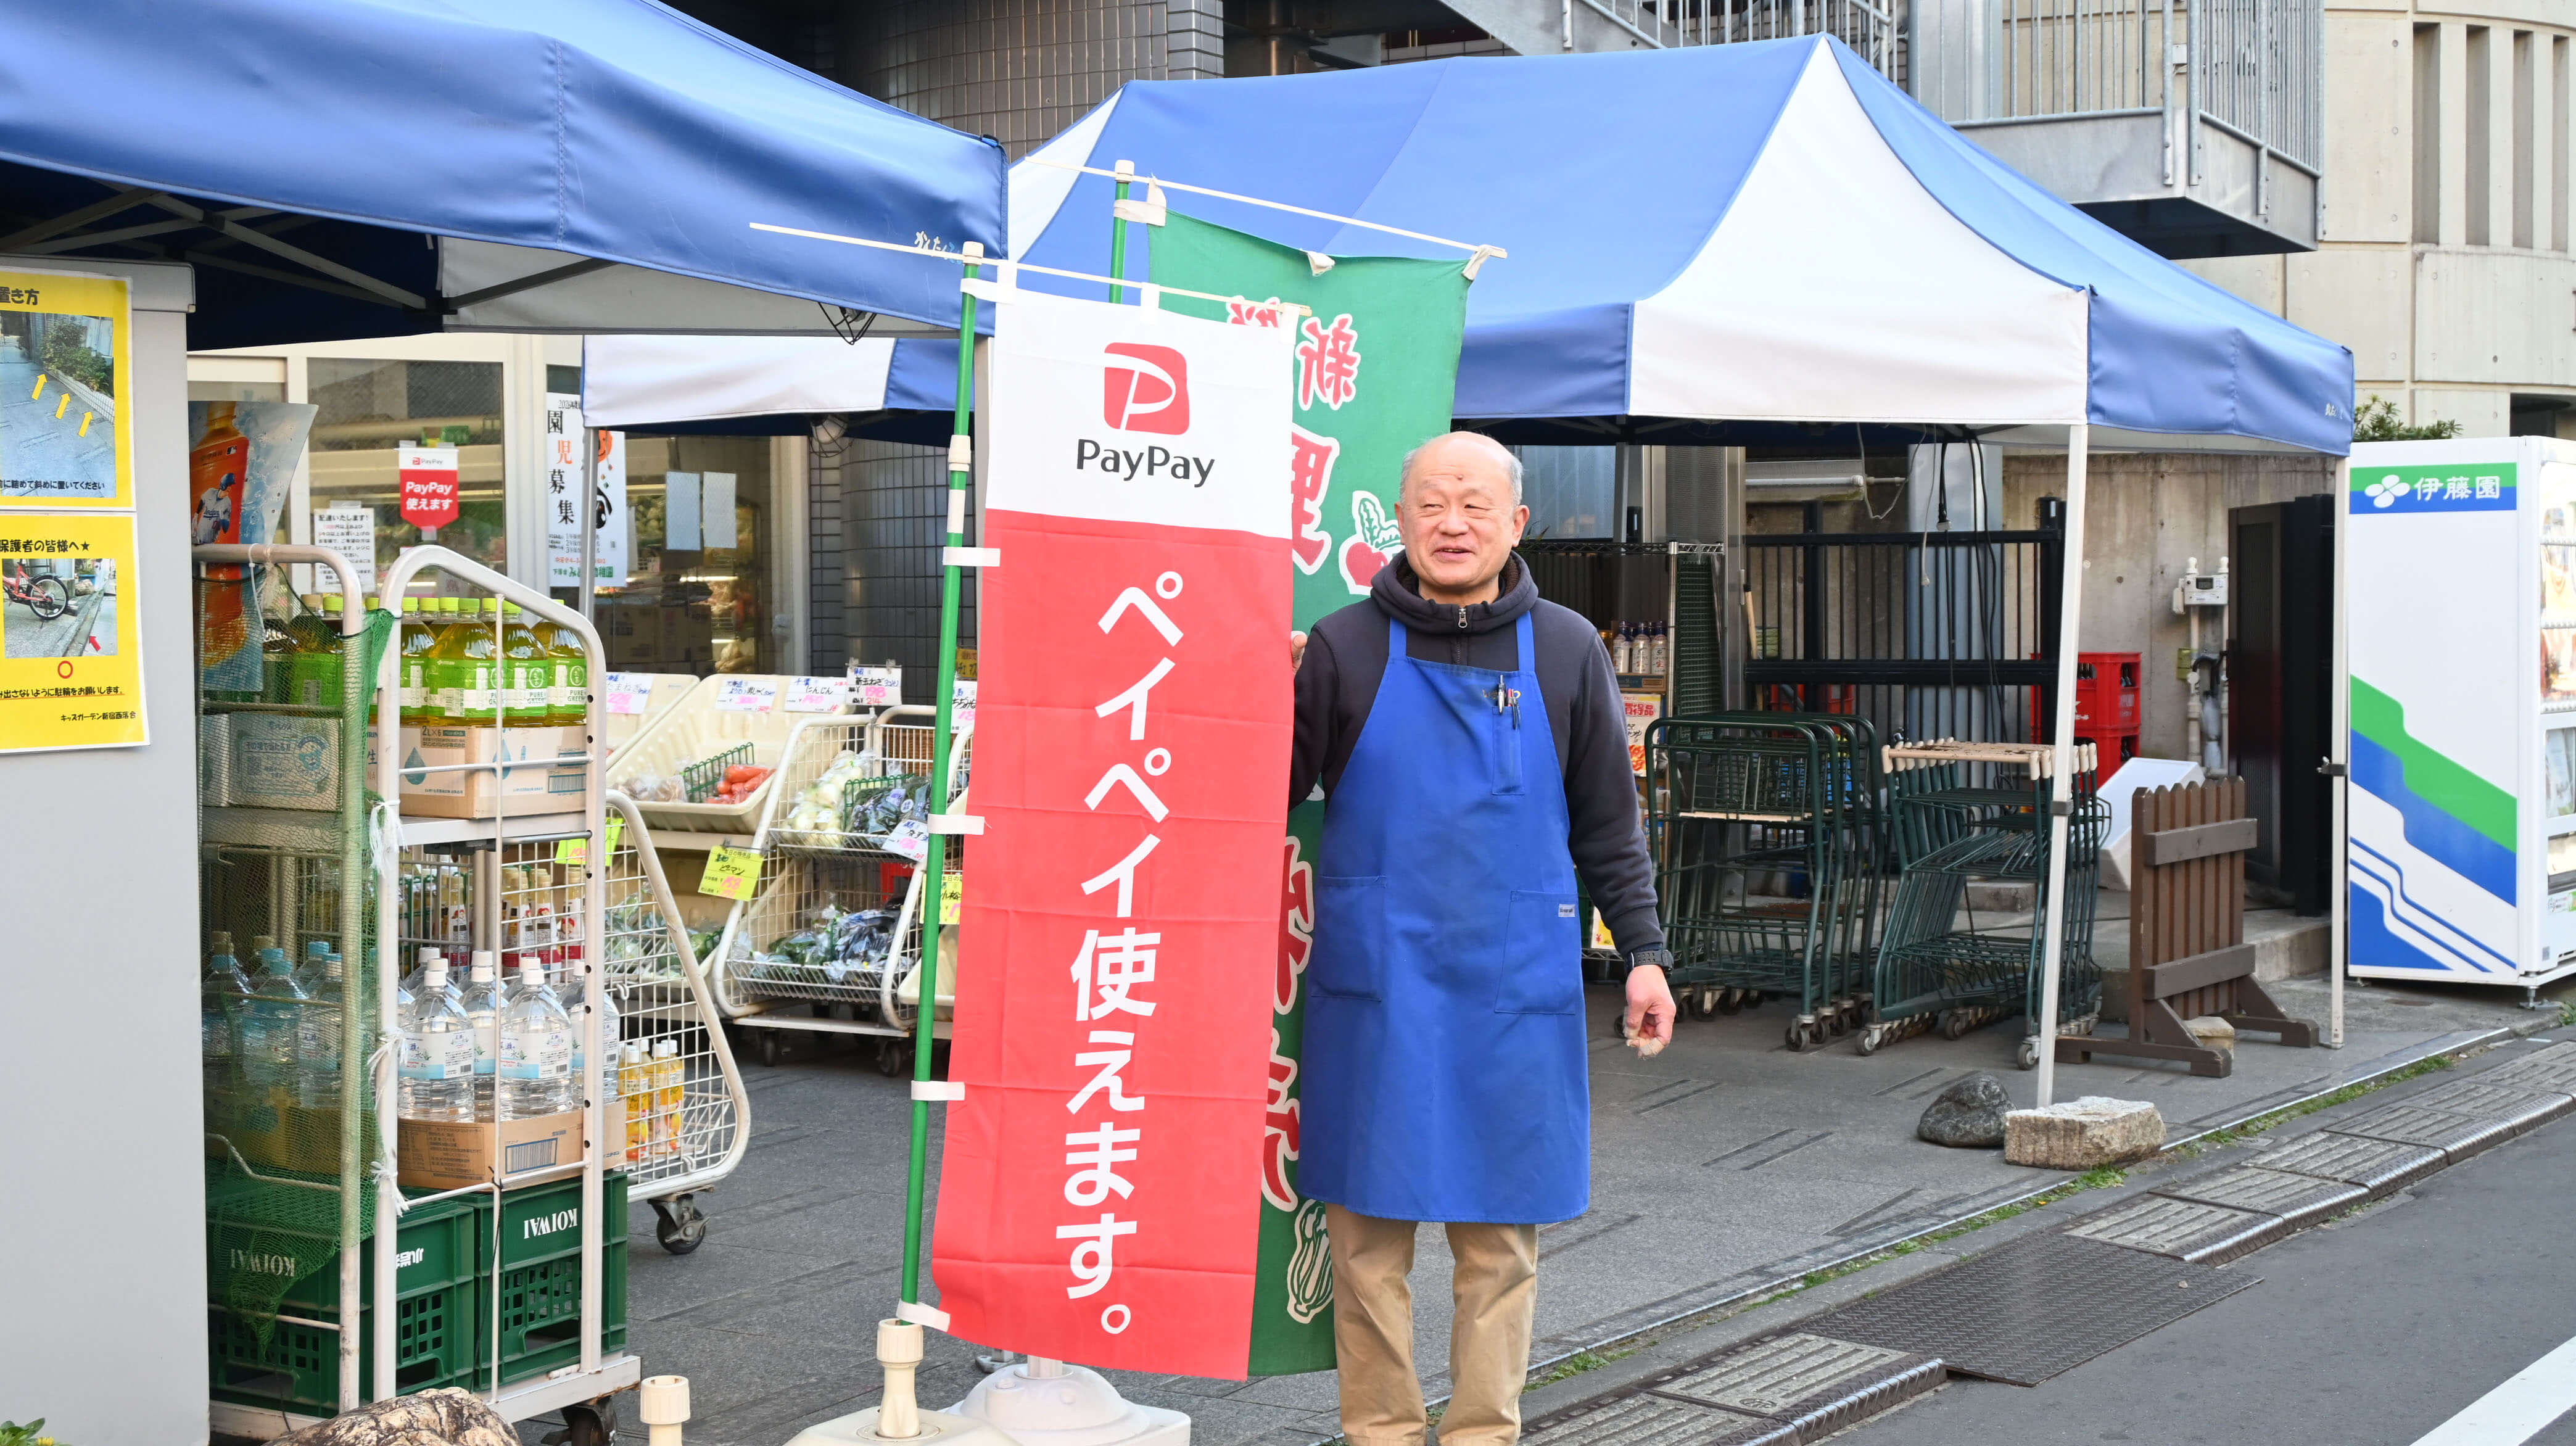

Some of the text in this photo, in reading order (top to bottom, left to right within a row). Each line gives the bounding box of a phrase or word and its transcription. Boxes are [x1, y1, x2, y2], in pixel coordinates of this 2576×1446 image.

[0, 286, 40, 305] 置き方
[1076, 439, 1215, 488] PayPay
[405, 481, 453, 495] PayPay
[2414, 475, 2501, 502] 伊藤園
[406, 497, 453, 511] 使えます
[719, 864, 745, 875] ピーマン
[1056, 571, 1184, 1335] ペイペイ使えます。
[524, 1208, 578, 1239] KOIWAI
